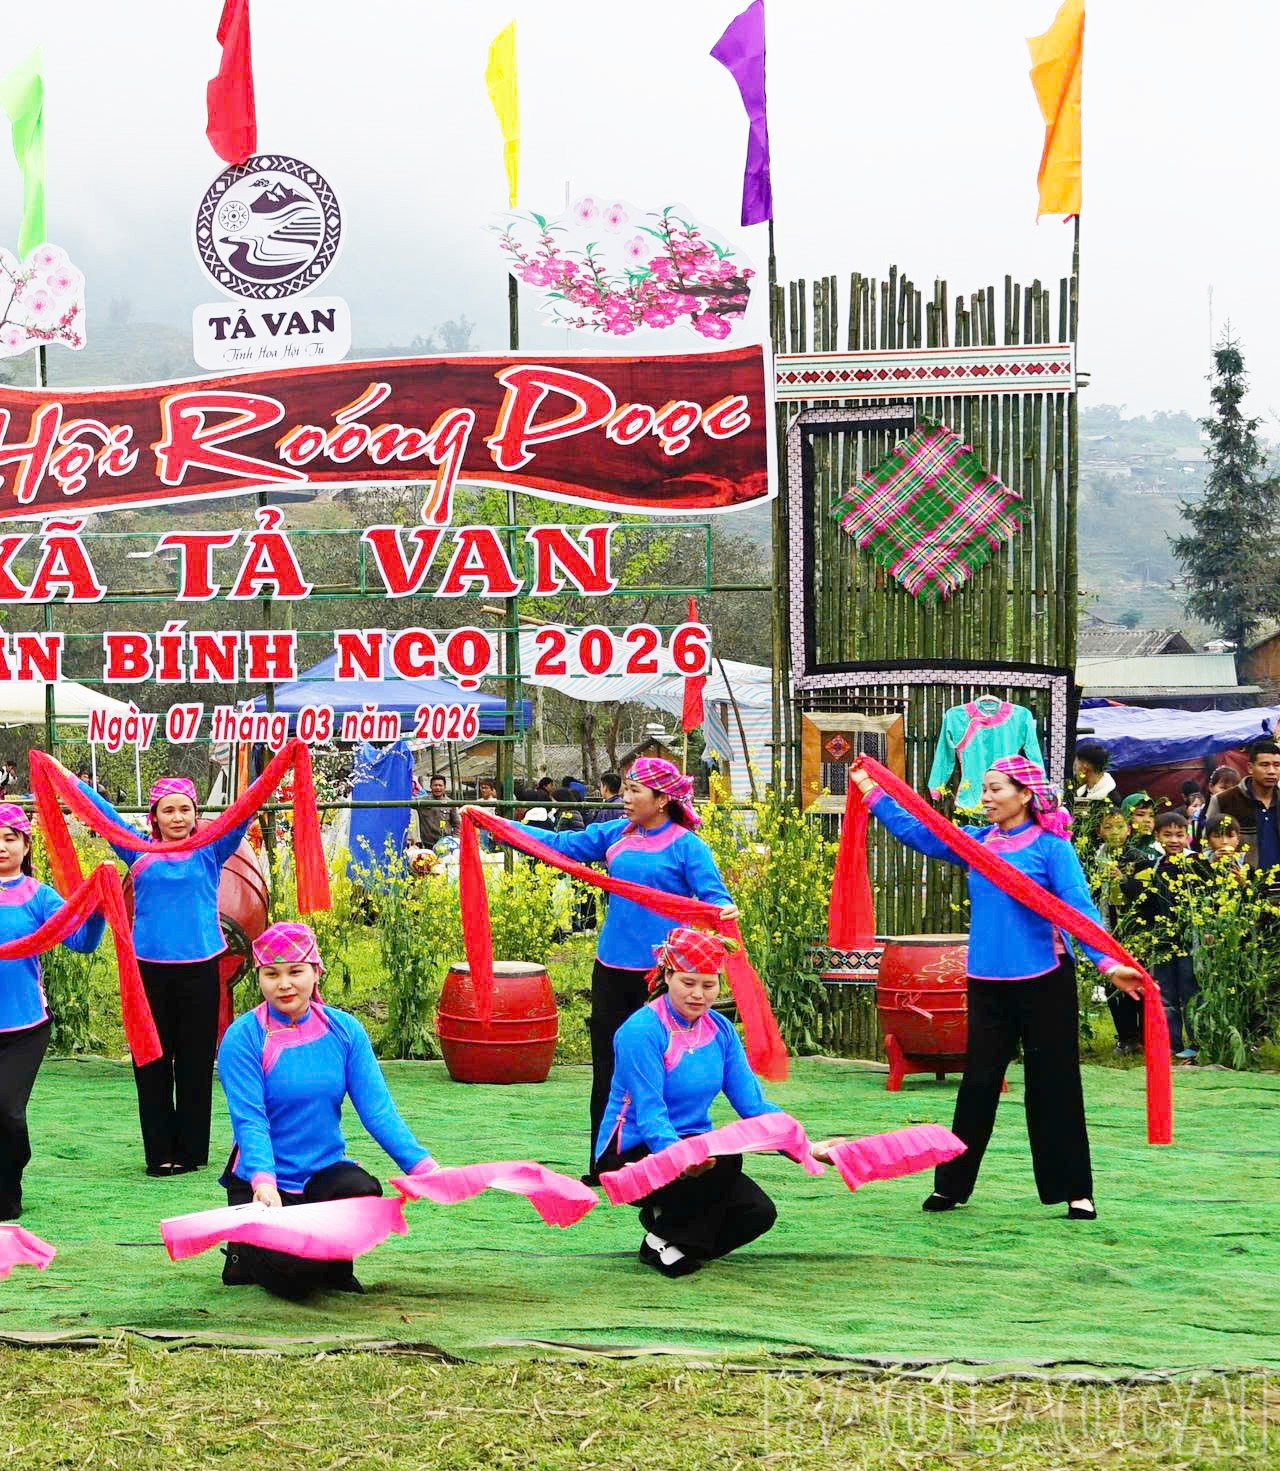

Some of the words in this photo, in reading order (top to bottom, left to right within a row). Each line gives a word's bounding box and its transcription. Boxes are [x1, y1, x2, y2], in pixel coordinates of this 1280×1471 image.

[208, 308, 256, 341] TẢ
[261, 308, 336, 337] VAN
[255, 345, 277, 362] Hoa
[151, 383, 475, 525] Roóng
[485, 364, 751, 470] Poọc
[157, 507, 312, 600] TẢ
[363, 524, 618, 597] VAN
[105, 621, 296, 683] BÍNH
[336, 628, 491, 690] NGỌ
[535, 623, 710, 676] 2026
[88, 704, 155, 750] Ngày
[168, 706, 201, 740] 07
[214, 703, 287, 750] tháng
[298, 706, 332, 742] 03
[342, 705, 400, 741] năm
[416, 705, 479, 741] 2026
